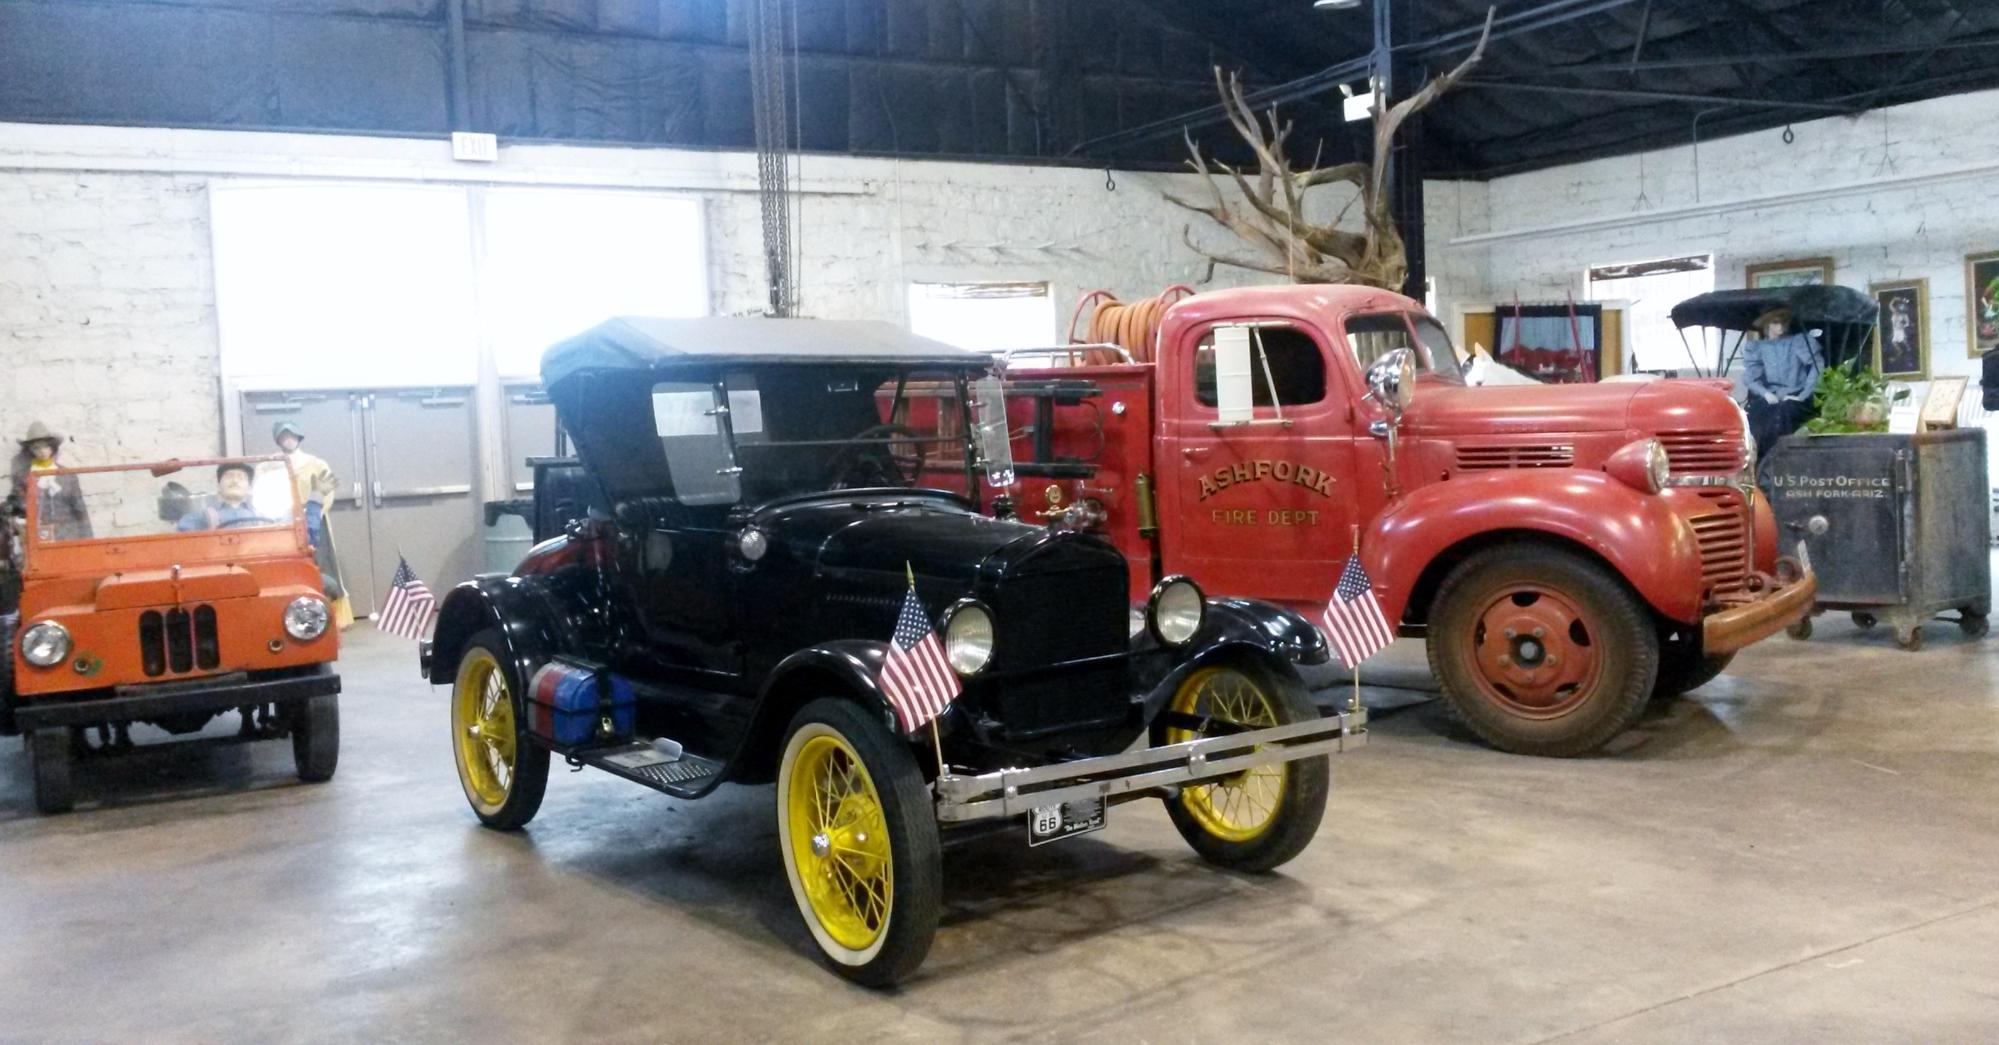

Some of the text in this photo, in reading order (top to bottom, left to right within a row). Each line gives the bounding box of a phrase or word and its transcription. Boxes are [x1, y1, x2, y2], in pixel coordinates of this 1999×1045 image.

[1199, 459, 1337, 501] ASHFORK
[1211, 510, 1319, 525] FIRE DEPT
[1040, 817, 1056, 832] 66
